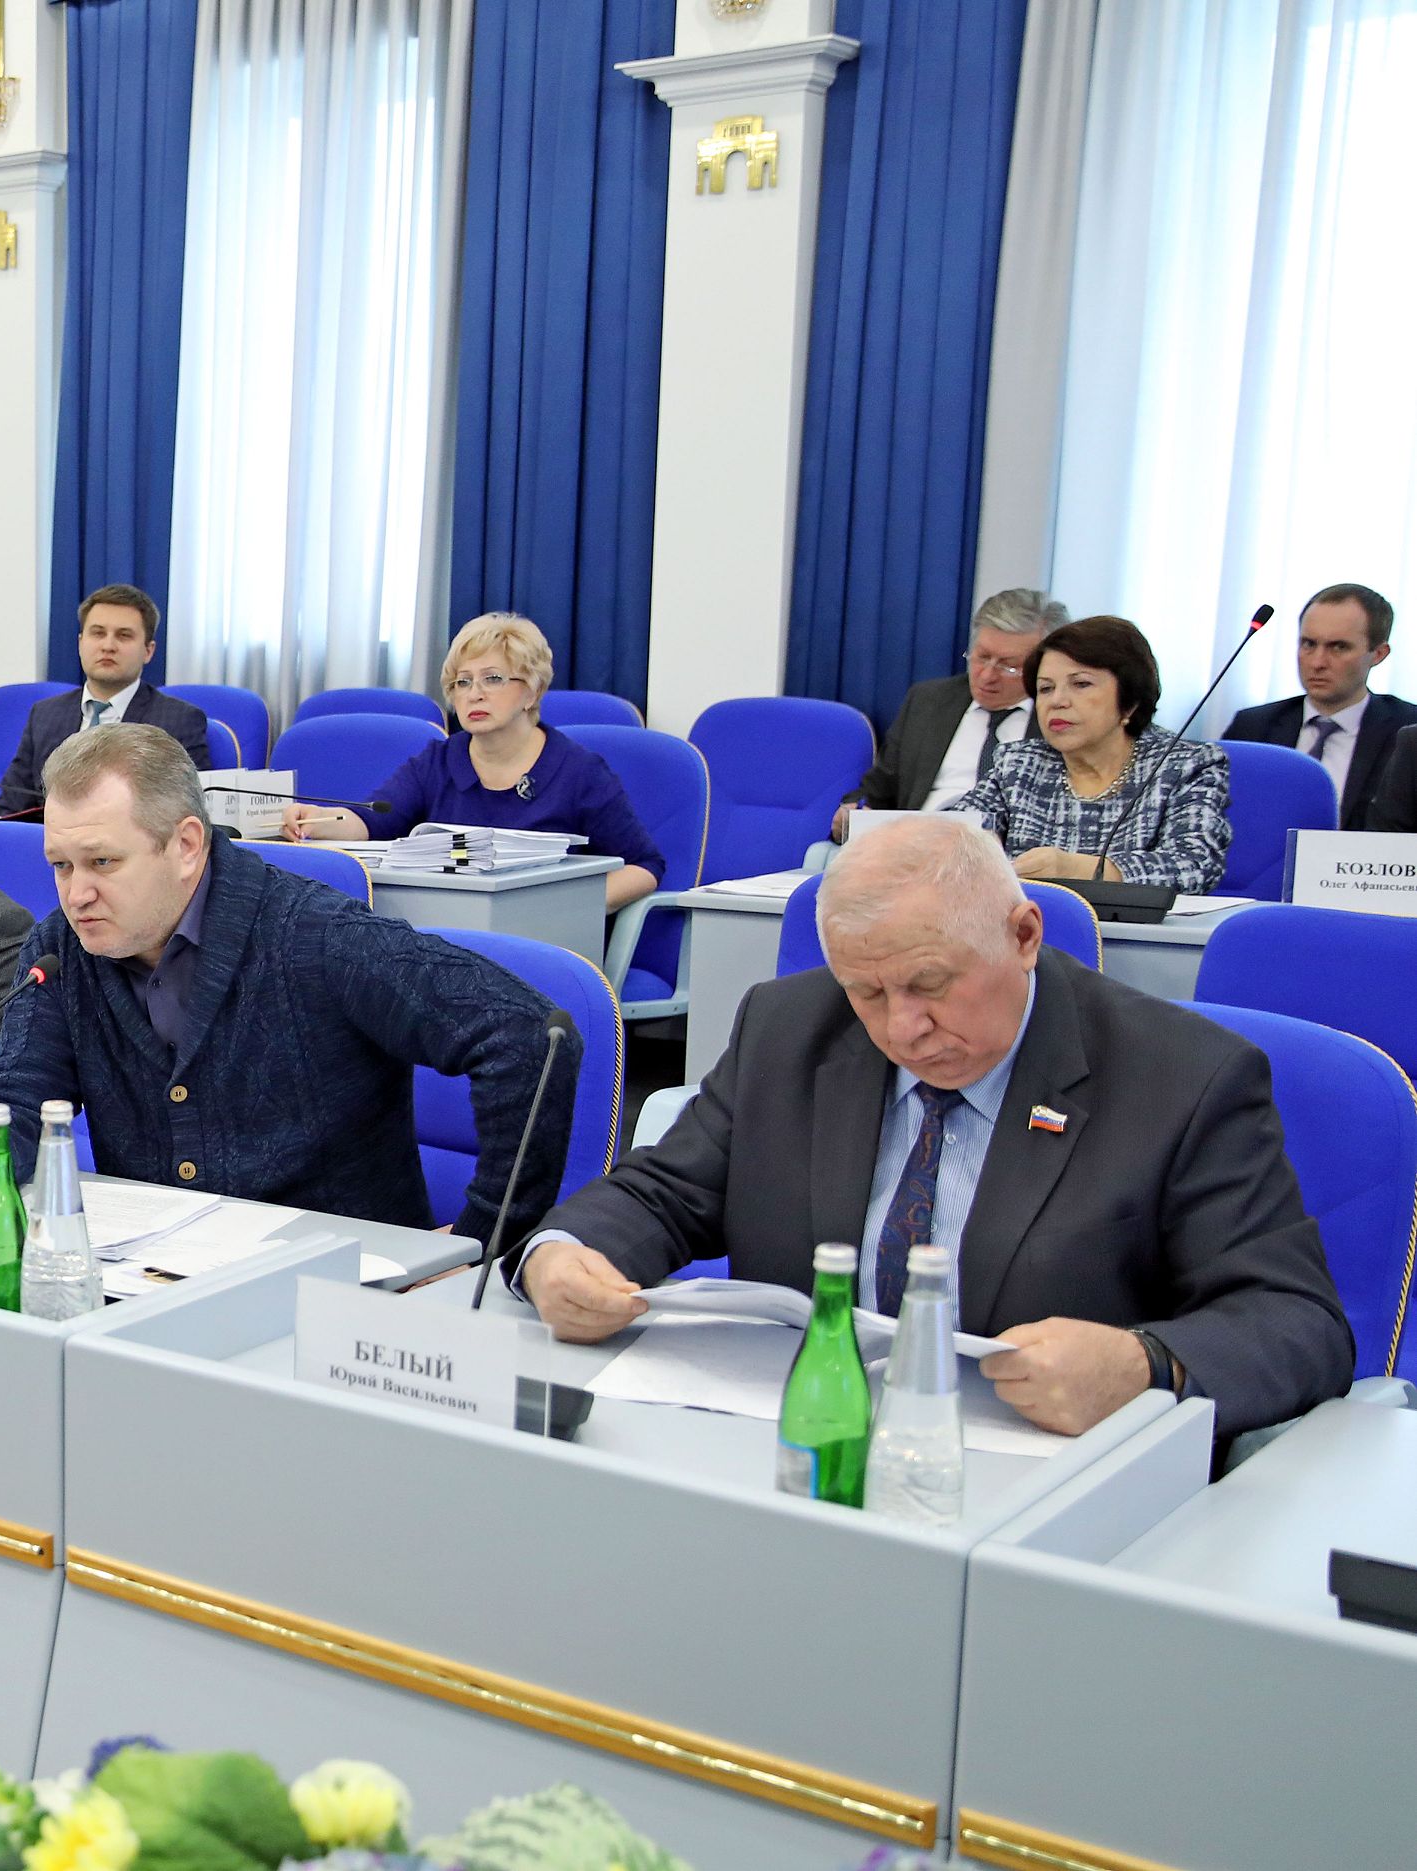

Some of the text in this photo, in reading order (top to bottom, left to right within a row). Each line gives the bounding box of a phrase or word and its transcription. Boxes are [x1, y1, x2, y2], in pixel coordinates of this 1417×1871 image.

[1335, 862, 1417, 877] КОЗЛОВ
[1319, 879, 1417, 892] Олег Афанасьев
[355, 1339, 454, 1382] БЕЛЫЙ
[329, 1364, 478, 1413] Юрий Васильевич
